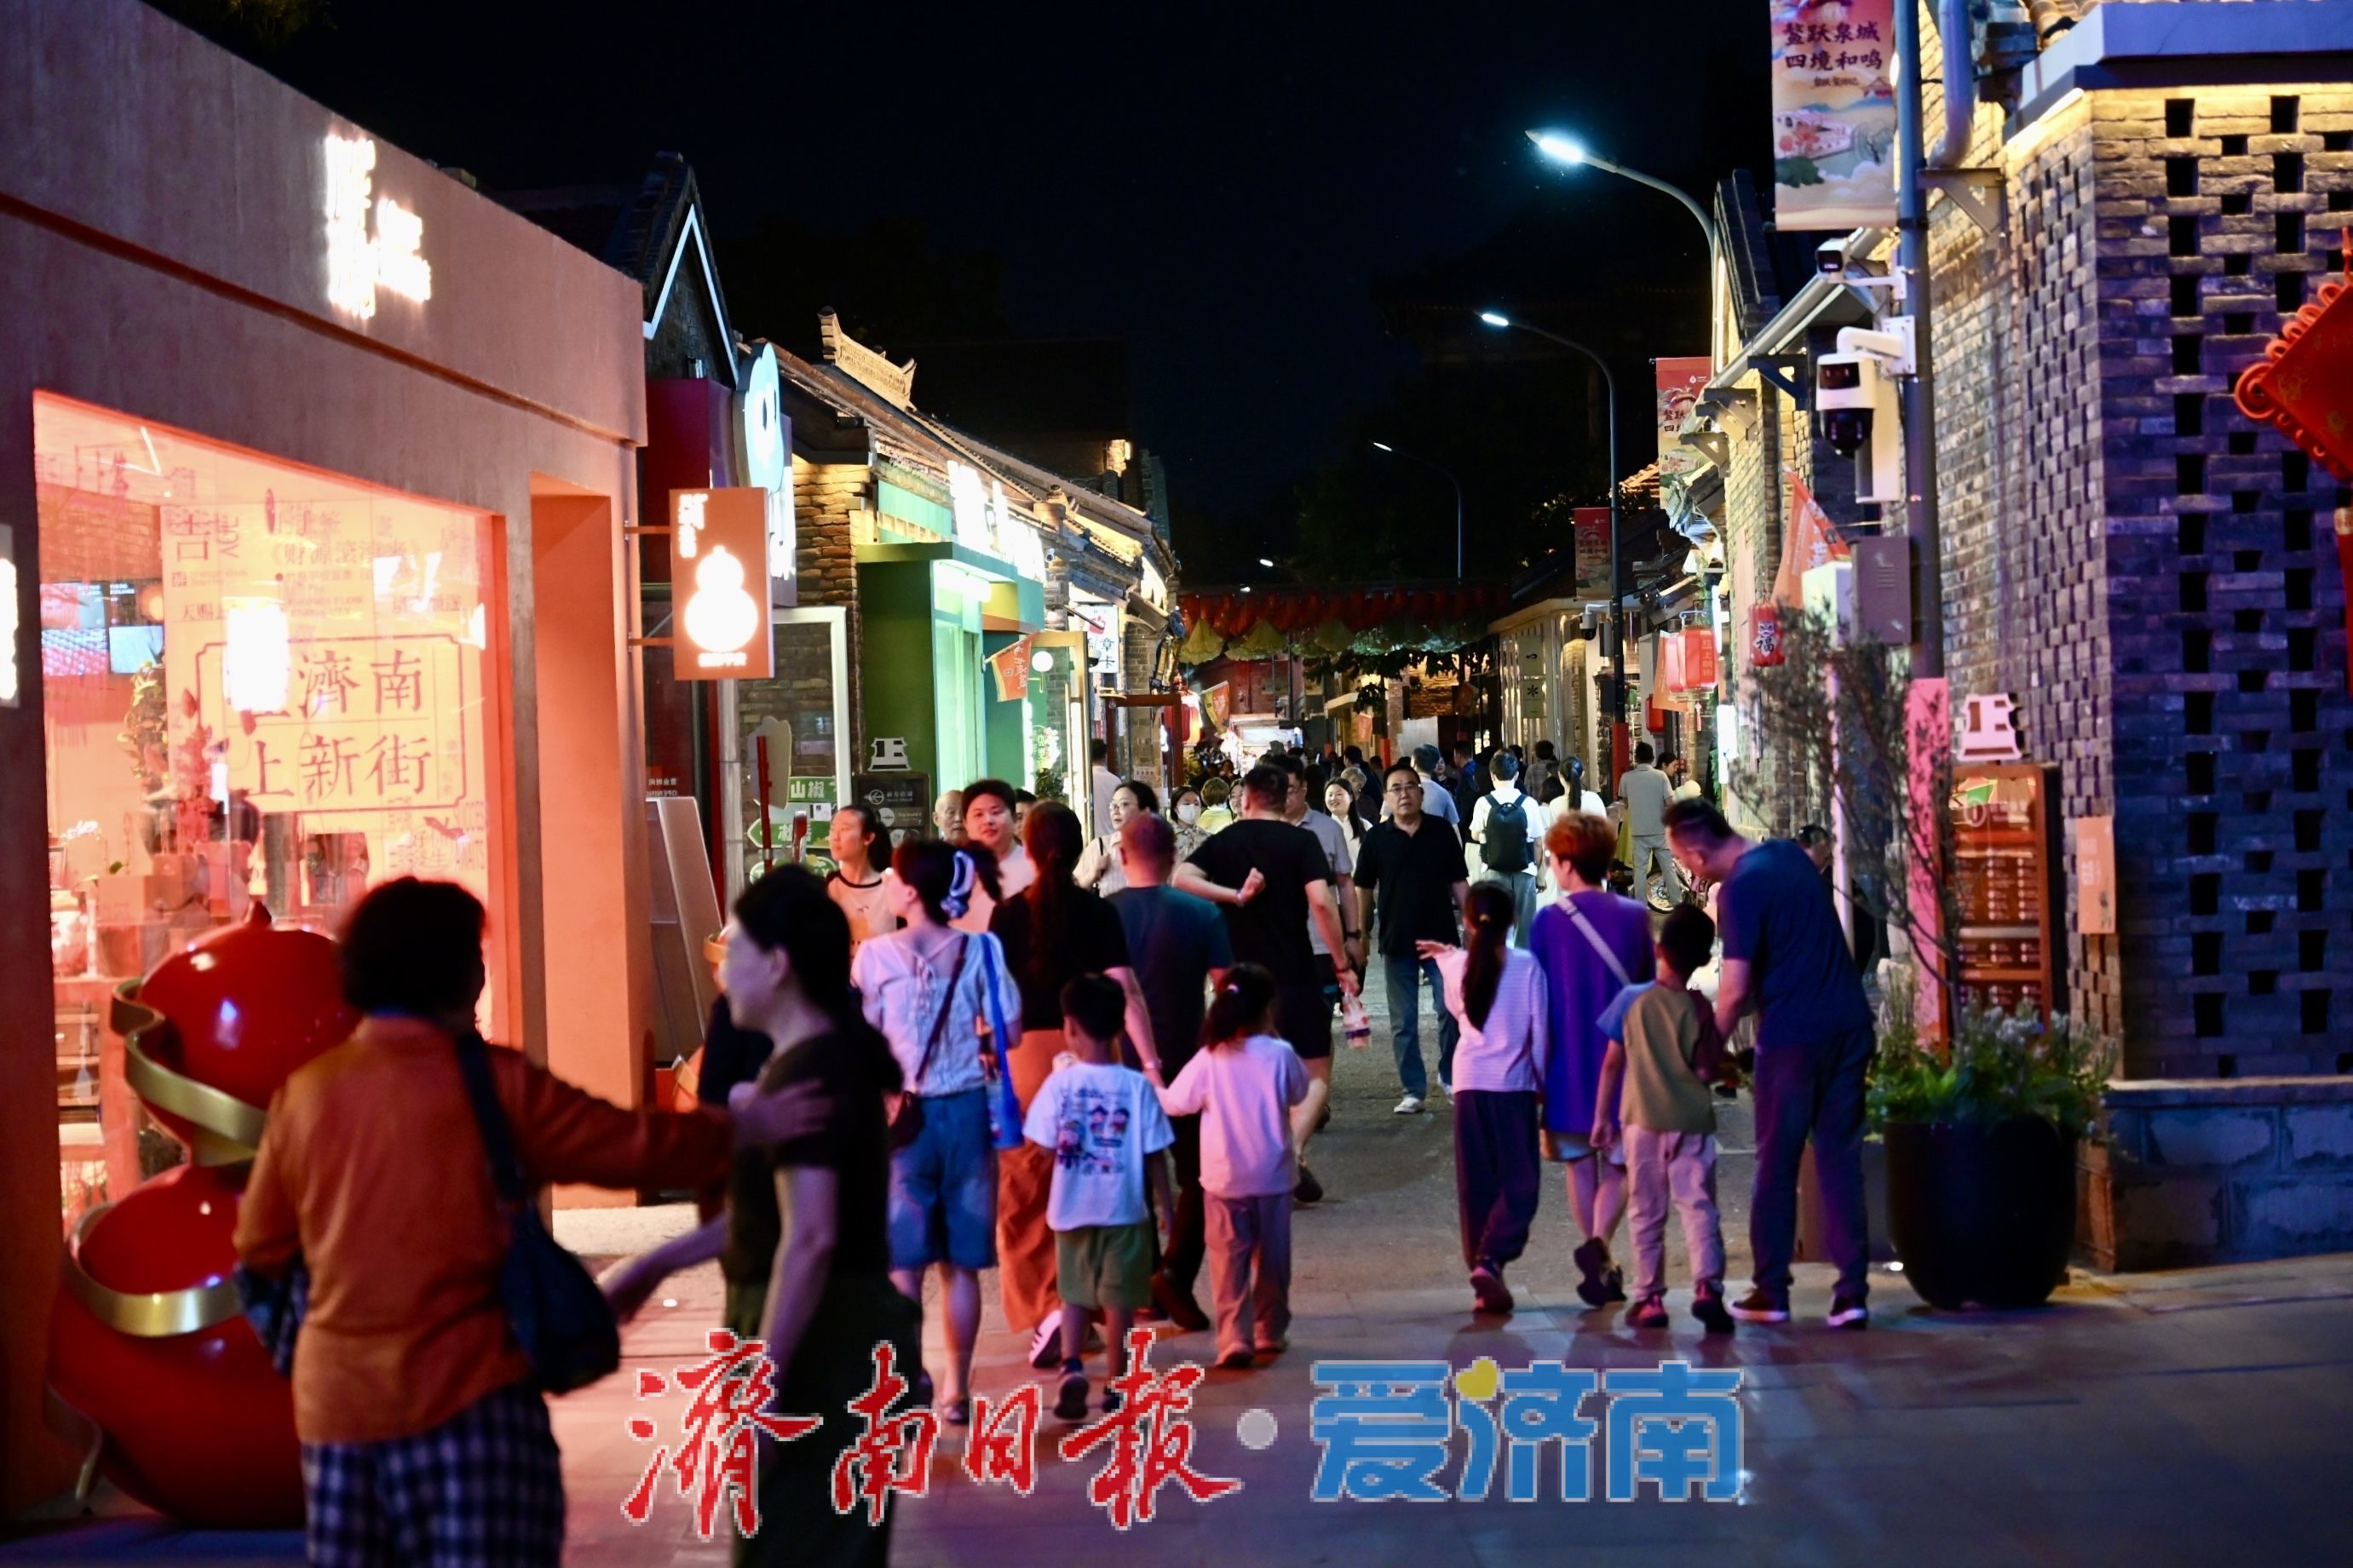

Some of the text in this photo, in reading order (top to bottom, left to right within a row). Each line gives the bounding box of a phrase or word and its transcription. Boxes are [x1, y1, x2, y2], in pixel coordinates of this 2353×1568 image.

[1786, 49, 1882, 70] 四境和鸣
[1757, 639, 1775, 653] 福
[247, 734, 432, 799] 上新街
